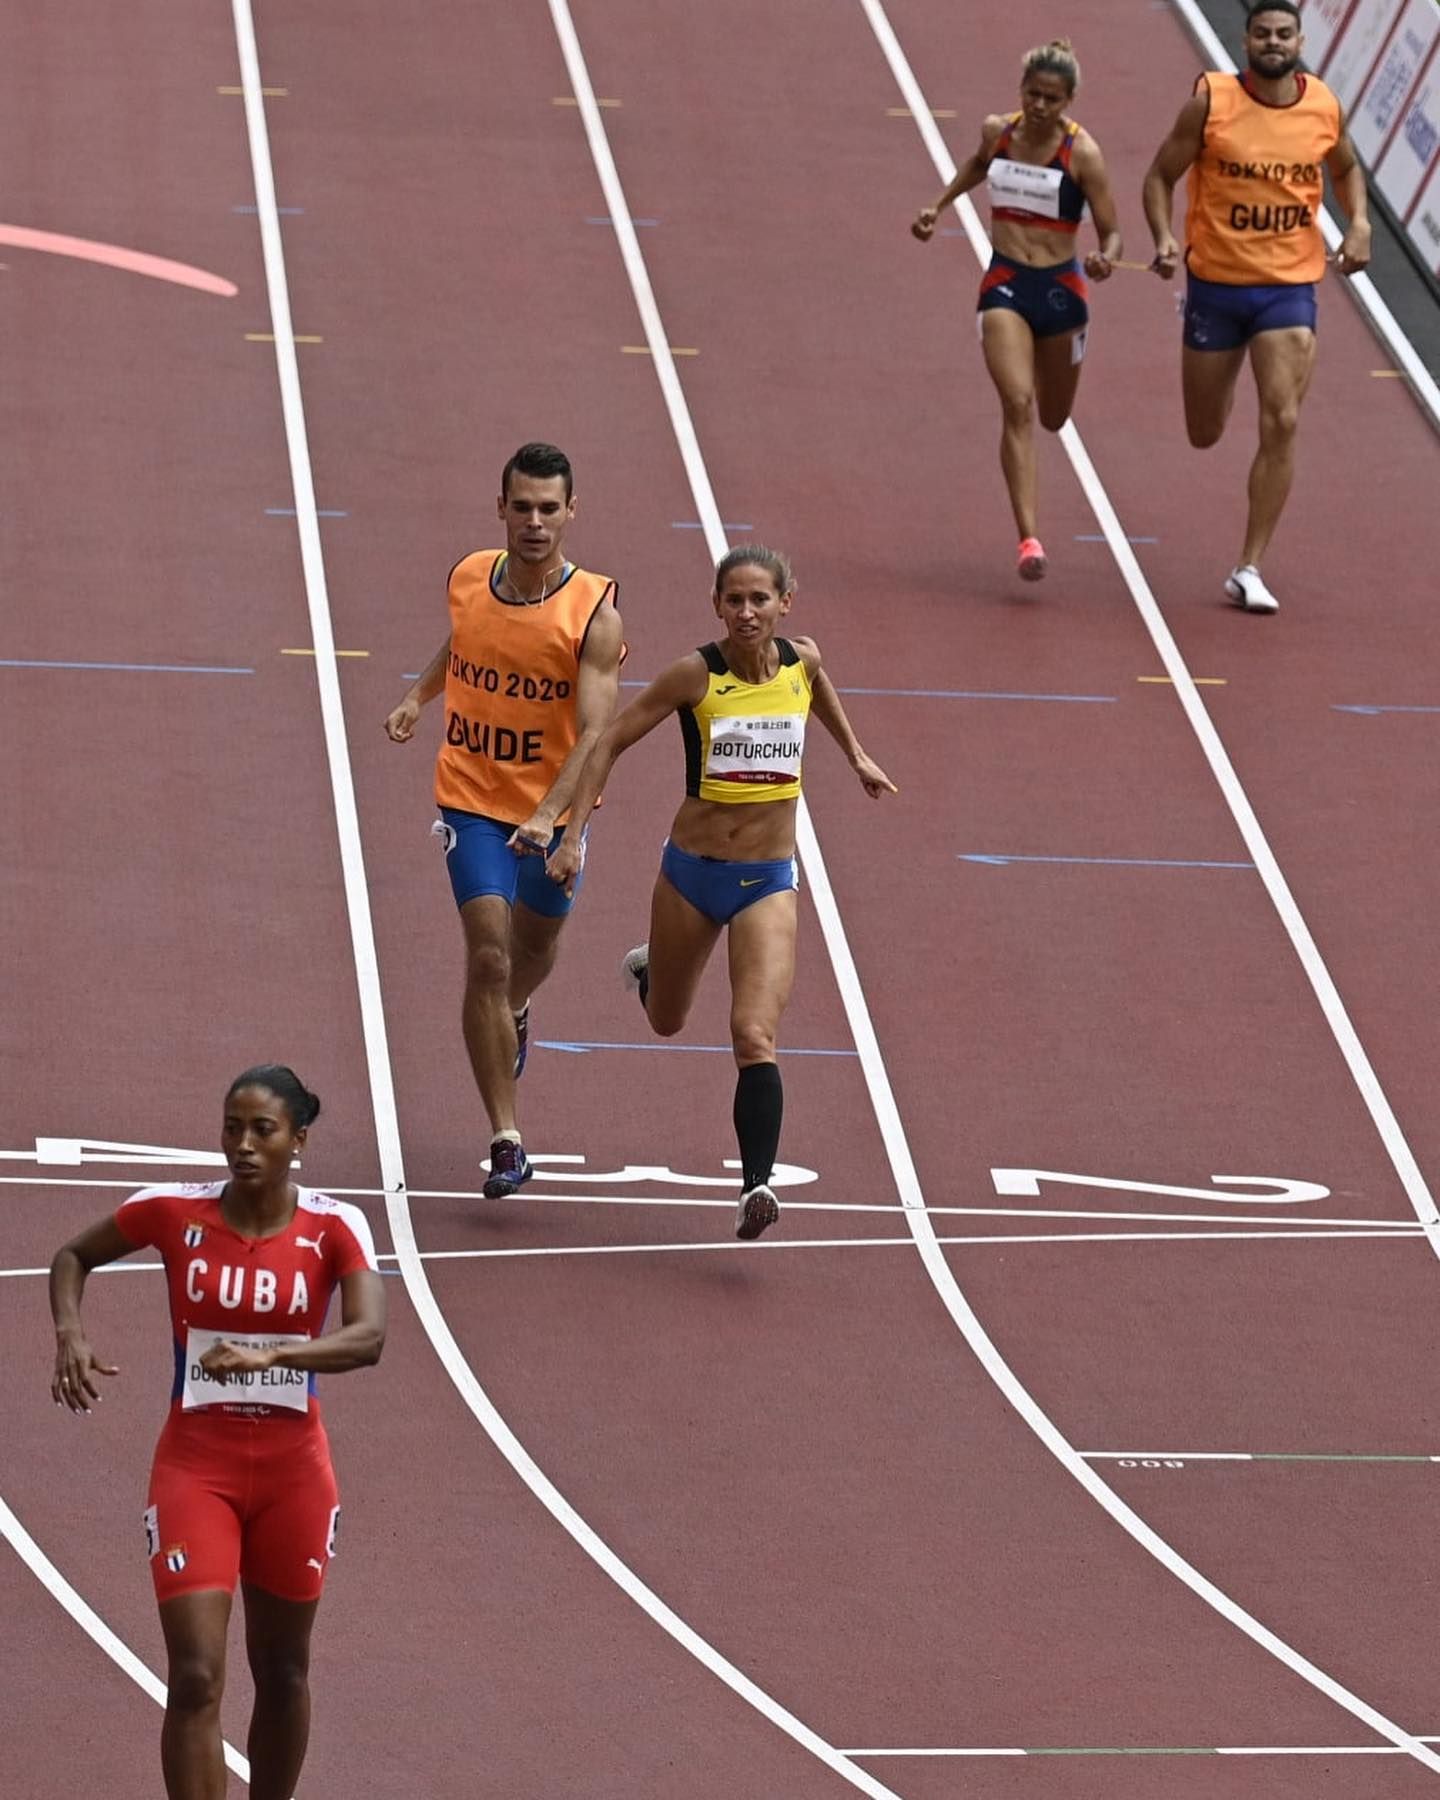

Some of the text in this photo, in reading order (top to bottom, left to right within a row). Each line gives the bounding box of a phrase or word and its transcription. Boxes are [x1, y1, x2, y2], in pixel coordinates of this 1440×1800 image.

[1218, 160, 1286, 182] TOKYO
[1231, 203, 1312, 232] GUIDE
[448, 650, 570, 701] TOKYO 2020
[446, 711, 544, 763] GUIDE
[712, 742, 801, 759] BOTURCHUK
[990, 1168, 1331, 1203] 2
[187, 1258, 309, 1315] CUBA
[261, 1368, 305, 1386] ELIAS
